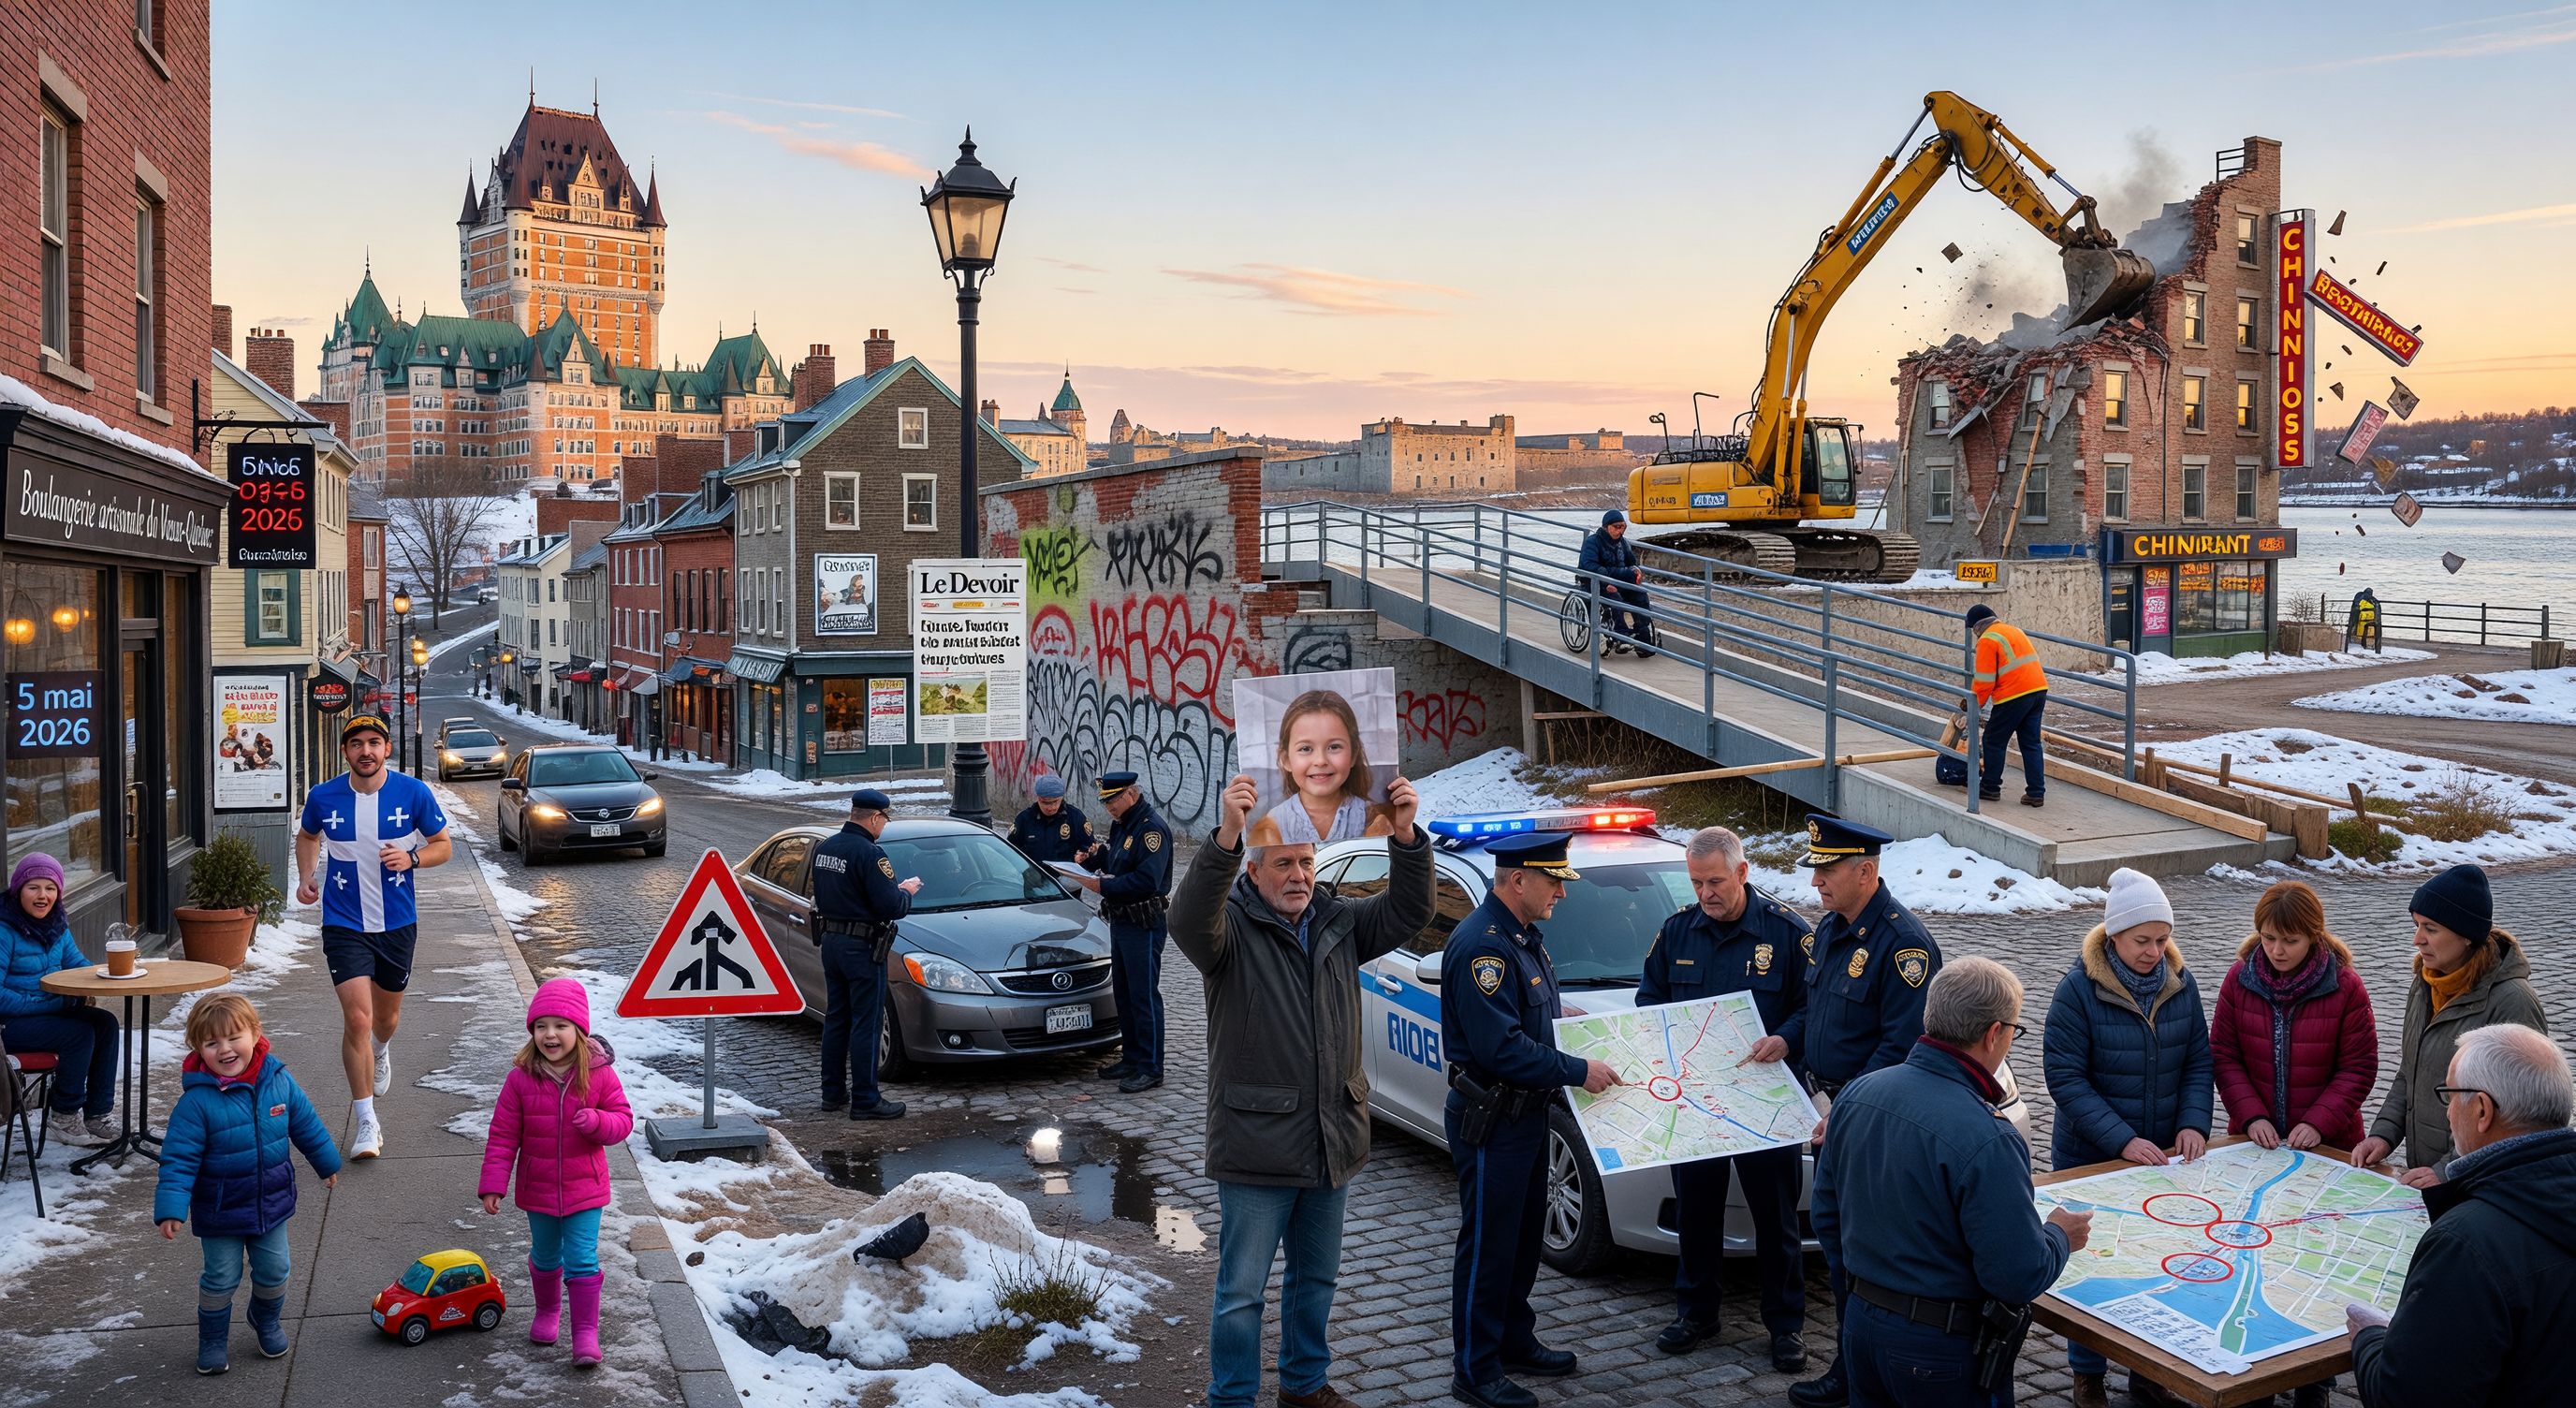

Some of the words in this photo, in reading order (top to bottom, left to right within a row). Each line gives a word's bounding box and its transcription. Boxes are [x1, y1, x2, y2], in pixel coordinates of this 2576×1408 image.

[2282, 227, 2303, 461] CHINNIOSS
[20, 469, 96, 539] Boulangerie
[241, 507, 303, 532] 2026
[920, 572, 947, 594] Le
[948, 572, 1020, 594] Devoir
[17, 682, 36, 711] 5
[44, 681, 92, 710] mai
[20, 717, 91, 746] 2026
